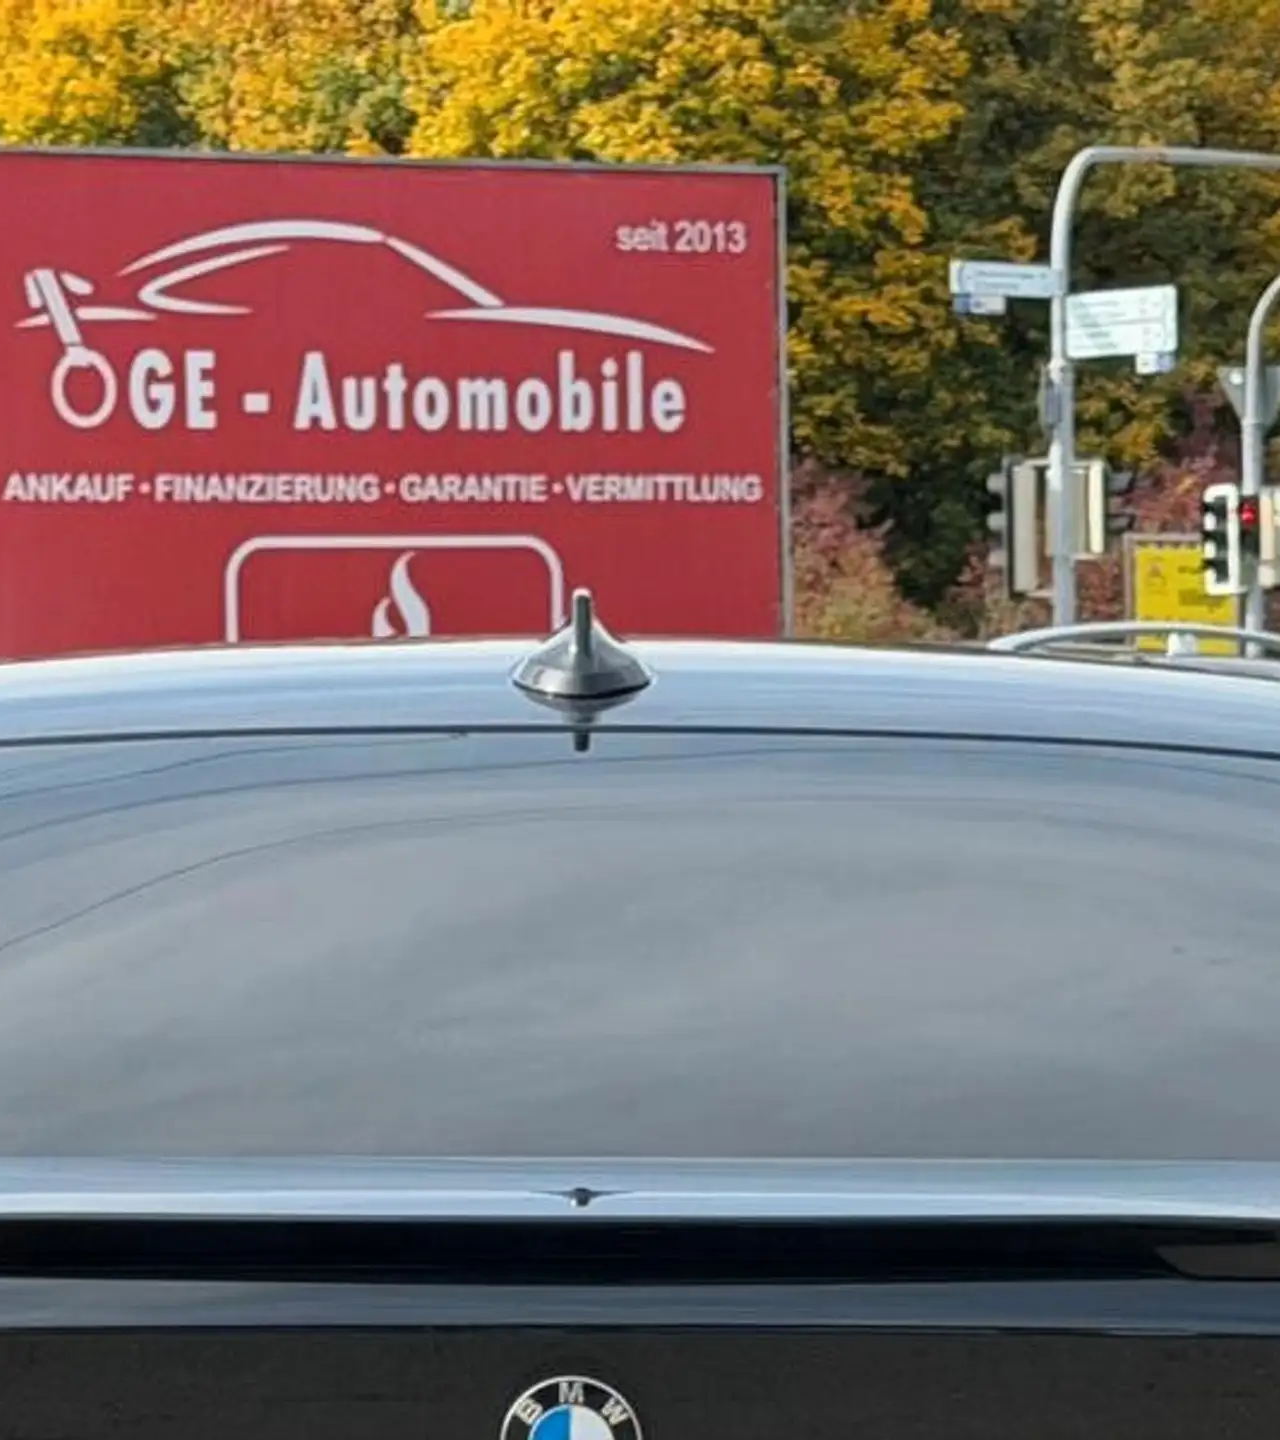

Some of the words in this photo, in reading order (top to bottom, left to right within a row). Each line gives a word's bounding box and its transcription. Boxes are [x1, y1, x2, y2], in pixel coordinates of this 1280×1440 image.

[616, 222, 669, 252] seit
[675, 222, 746, 252] 2013
[294, 350, 686, 433] Automobile
[3, 473, 134, 503] ANKAUF
[154, 473, 381, 503] FINANZIERUNG
[399, 473, 548, 503] GARANTIE
[566, 473, 763, 503] VERMITTLUNG
[515, 1382, 630, 1427] BMW
